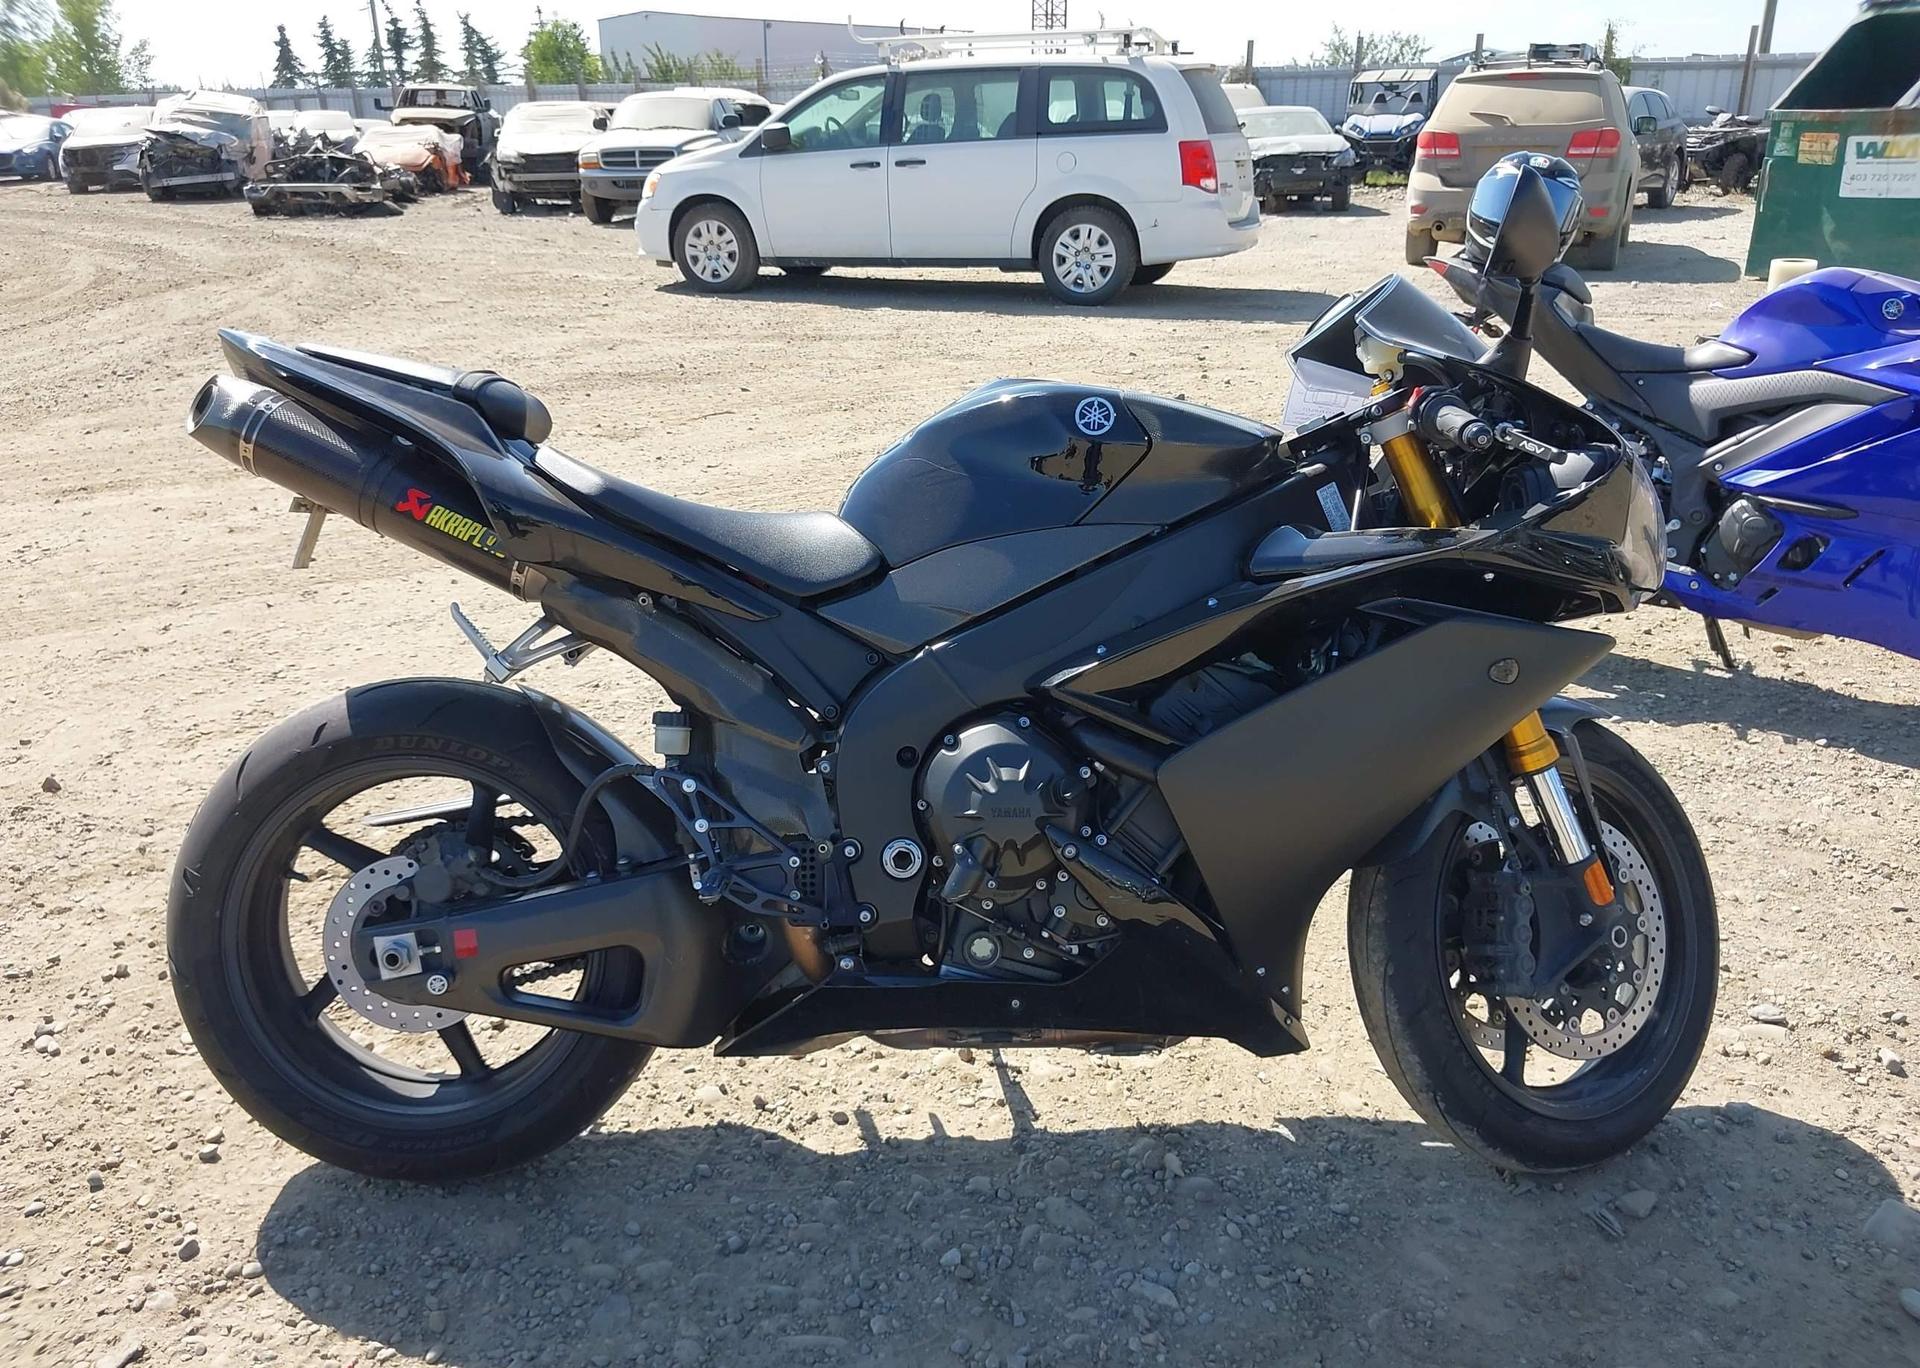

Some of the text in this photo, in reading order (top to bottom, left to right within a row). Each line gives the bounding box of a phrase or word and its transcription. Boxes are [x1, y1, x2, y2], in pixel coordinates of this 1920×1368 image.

[1519, 440, 1545, 454] ASV
[373, 735, 511, 768] DUNLOP
[991, 807, 1033, 818] YAMAHA
